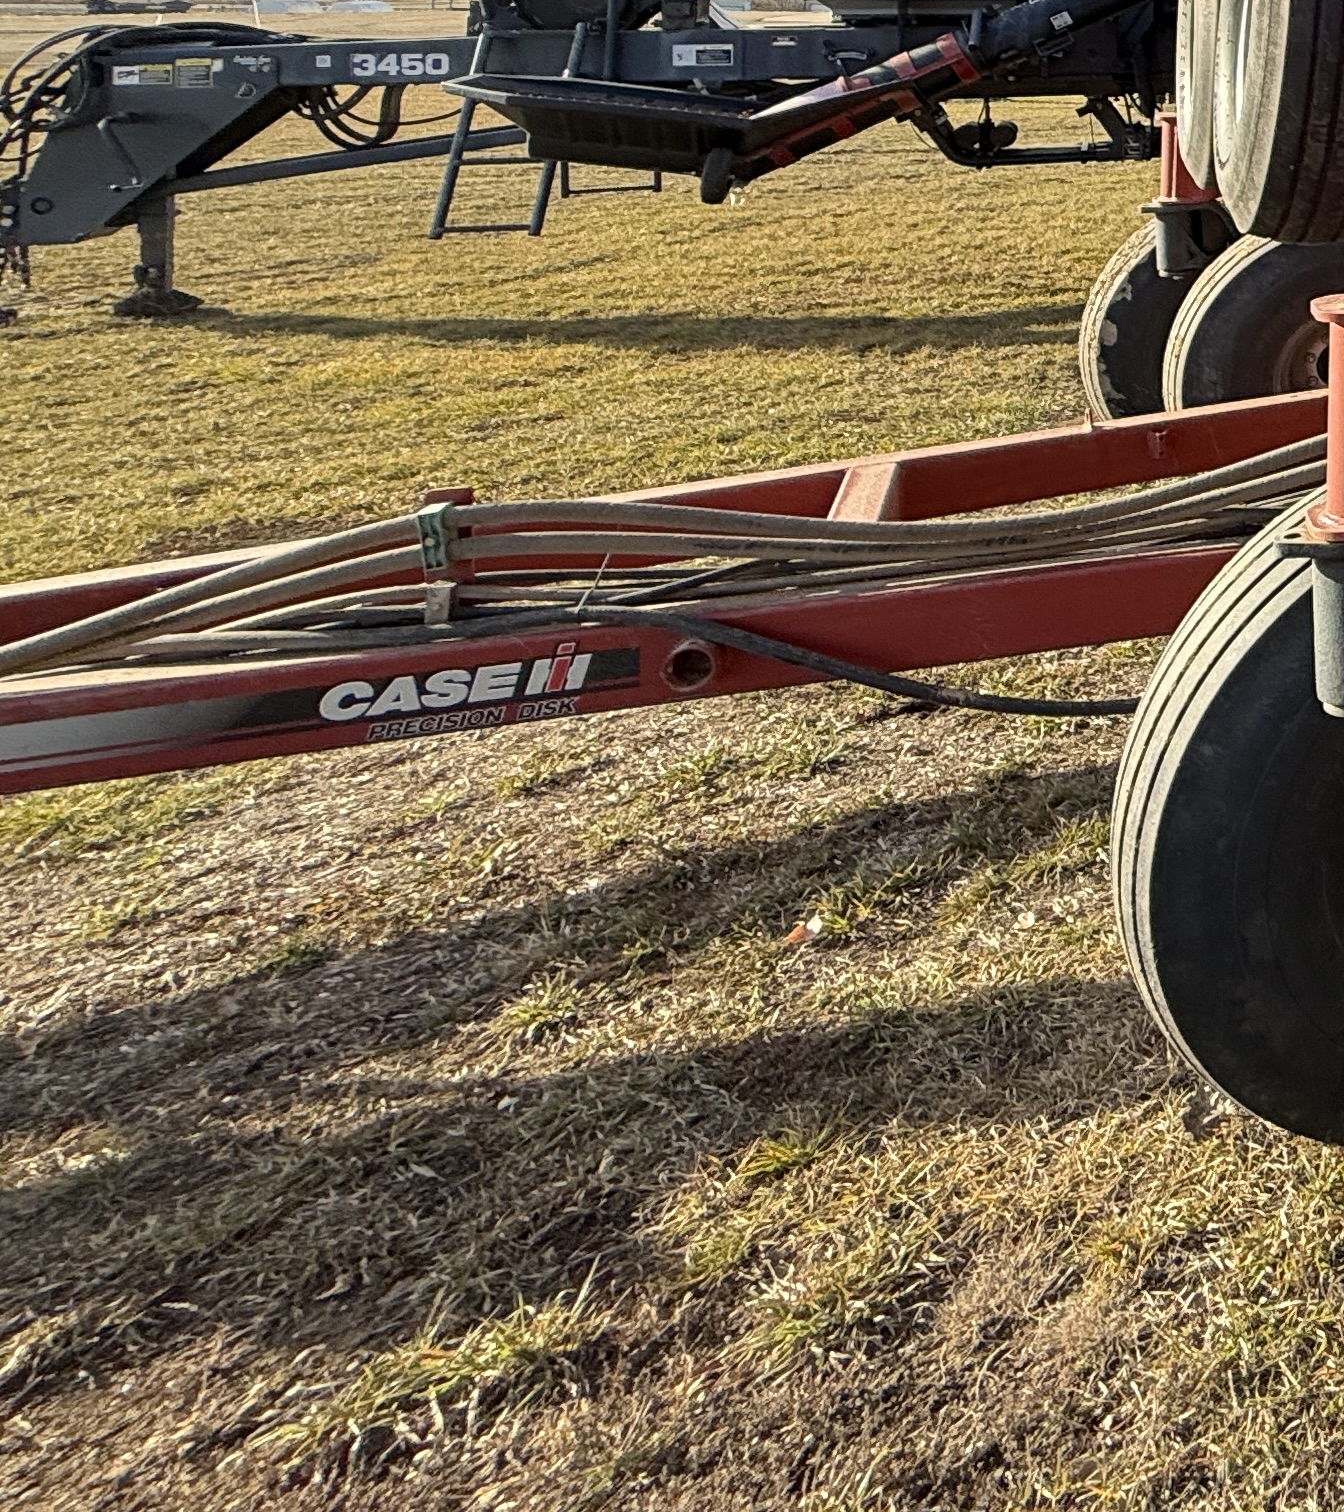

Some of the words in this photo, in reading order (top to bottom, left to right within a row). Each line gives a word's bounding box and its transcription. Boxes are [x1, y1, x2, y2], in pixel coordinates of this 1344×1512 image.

[353, 52, 450, 77] 3450
[318, 661, 523, 721] CASE
[524, 641, 593, 696] IH
[367, 706, 504, 741] PRECISION
[516, 695, 581, 722] DISK
